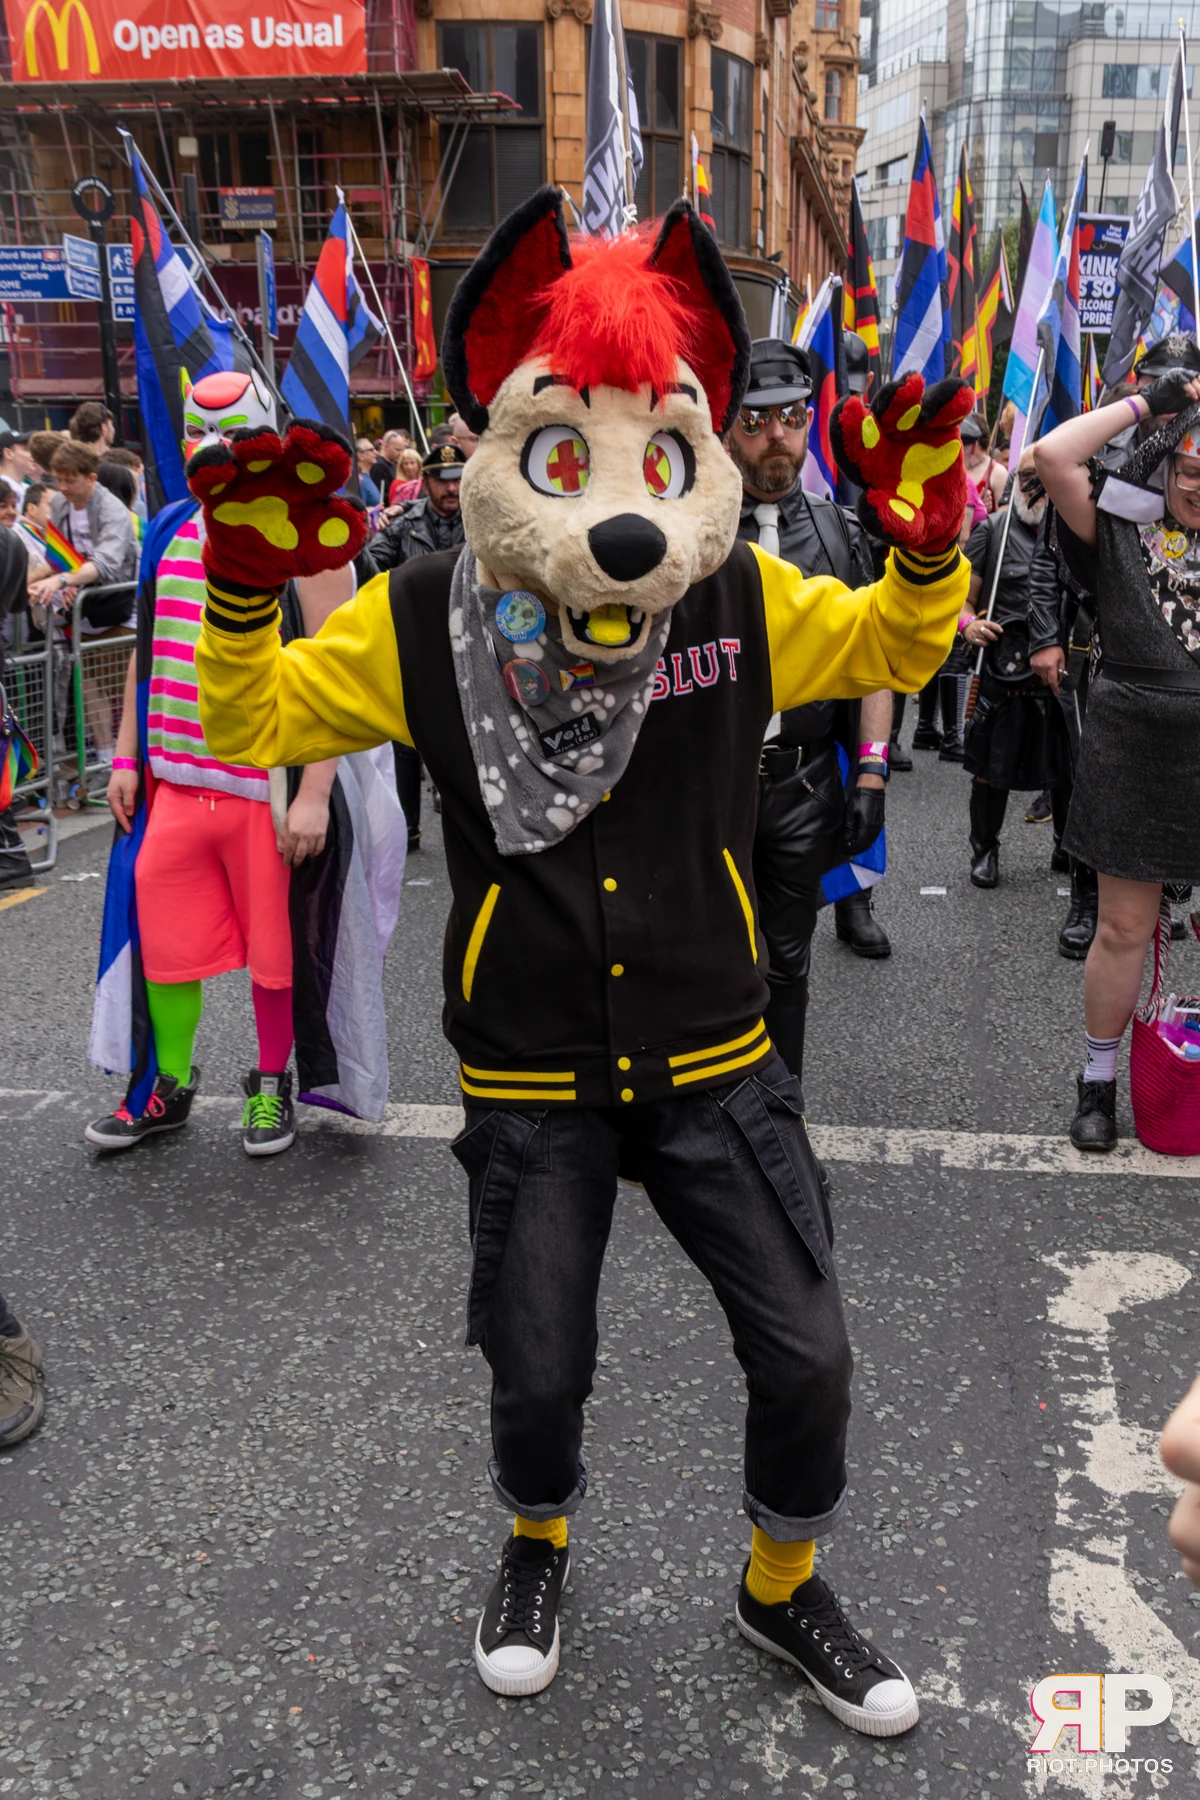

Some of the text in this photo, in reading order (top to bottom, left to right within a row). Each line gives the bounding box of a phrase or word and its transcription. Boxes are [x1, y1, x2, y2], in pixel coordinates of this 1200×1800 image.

[113, 14, 343, 60] Open as Usual
[235, 187, 259, 196] CCTV
[0, 250, 42, 260] ford Road
[41, 262, 67, 273] Aquat
[1079, 254, 1119, 277] KINK
[20, 271, 49, 280] Centre
[1079, 280, 1116, 298] S SO
[1079, 299, 1114, 312] ELCOME
[1083, 311, 1112, 325] PRIDE
[650, 638, 741, 700] SLUT
[543, 716, 591, 750] Void
